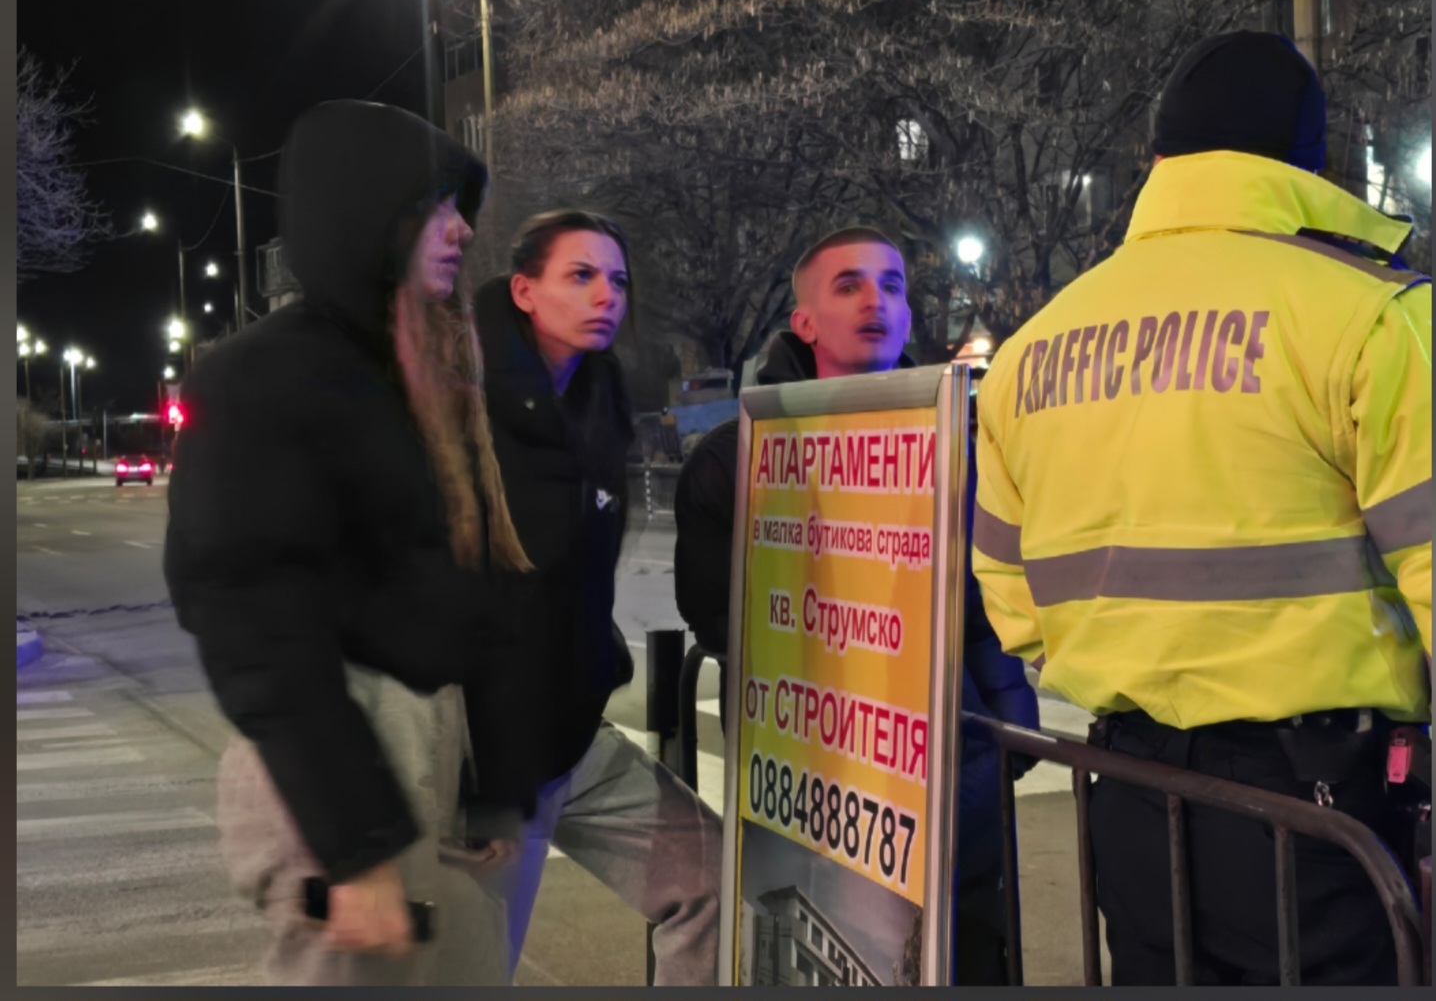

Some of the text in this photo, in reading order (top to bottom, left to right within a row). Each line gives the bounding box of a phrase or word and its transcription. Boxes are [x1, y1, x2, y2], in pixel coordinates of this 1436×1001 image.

[1014, 309, 1270, 419] TRAFFIC POLICE
[756, 432, 936, 488] АПАРТАМЕНТИ
[753, 515, 931, 565] в малка бутикова сграда
[770, 588, 902, 650] кв. Струмско
[745, 678, 928, 780] от СТРОИТЕЛЯ
[750, 753, 917, 885] 0884888787
